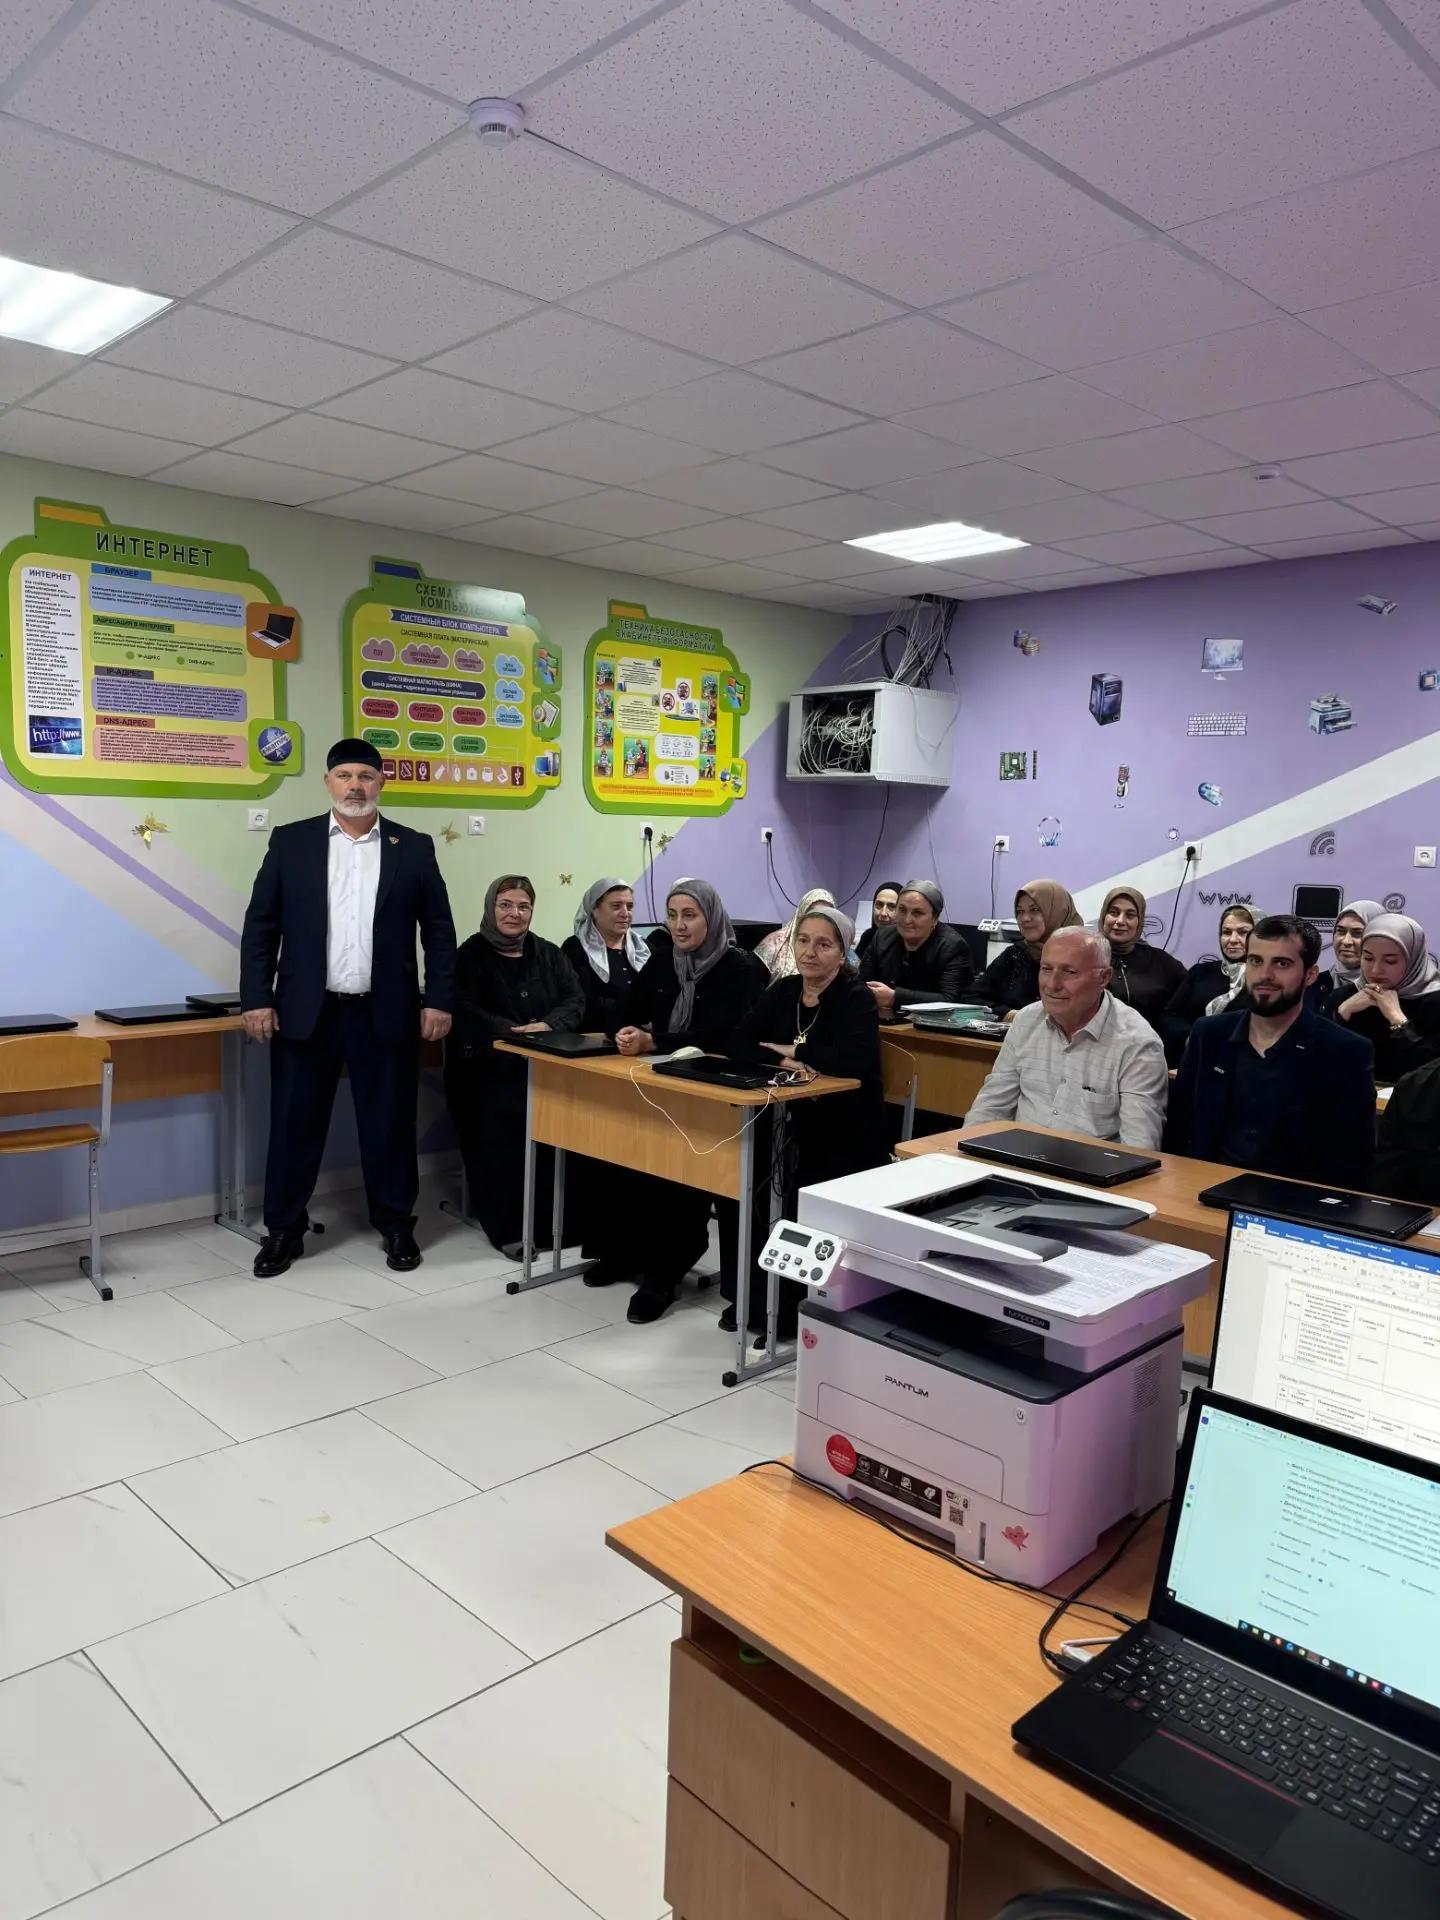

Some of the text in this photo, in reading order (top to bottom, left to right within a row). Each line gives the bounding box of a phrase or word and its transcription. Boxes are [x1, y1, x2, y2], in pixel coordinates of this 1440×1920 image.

[96, 531, 213, 567] ИНТЕРНЕТ
[29, 569, 72, 581] ИНТЕРНЕТ
[416, 583, 453, 599] СХЕМА
[400, 613, 441, 626] СИСТЕМНЫЙ
[441, 619, 458, 629] БЛОК
[885, 1375, 929, 1399] PANTUM
